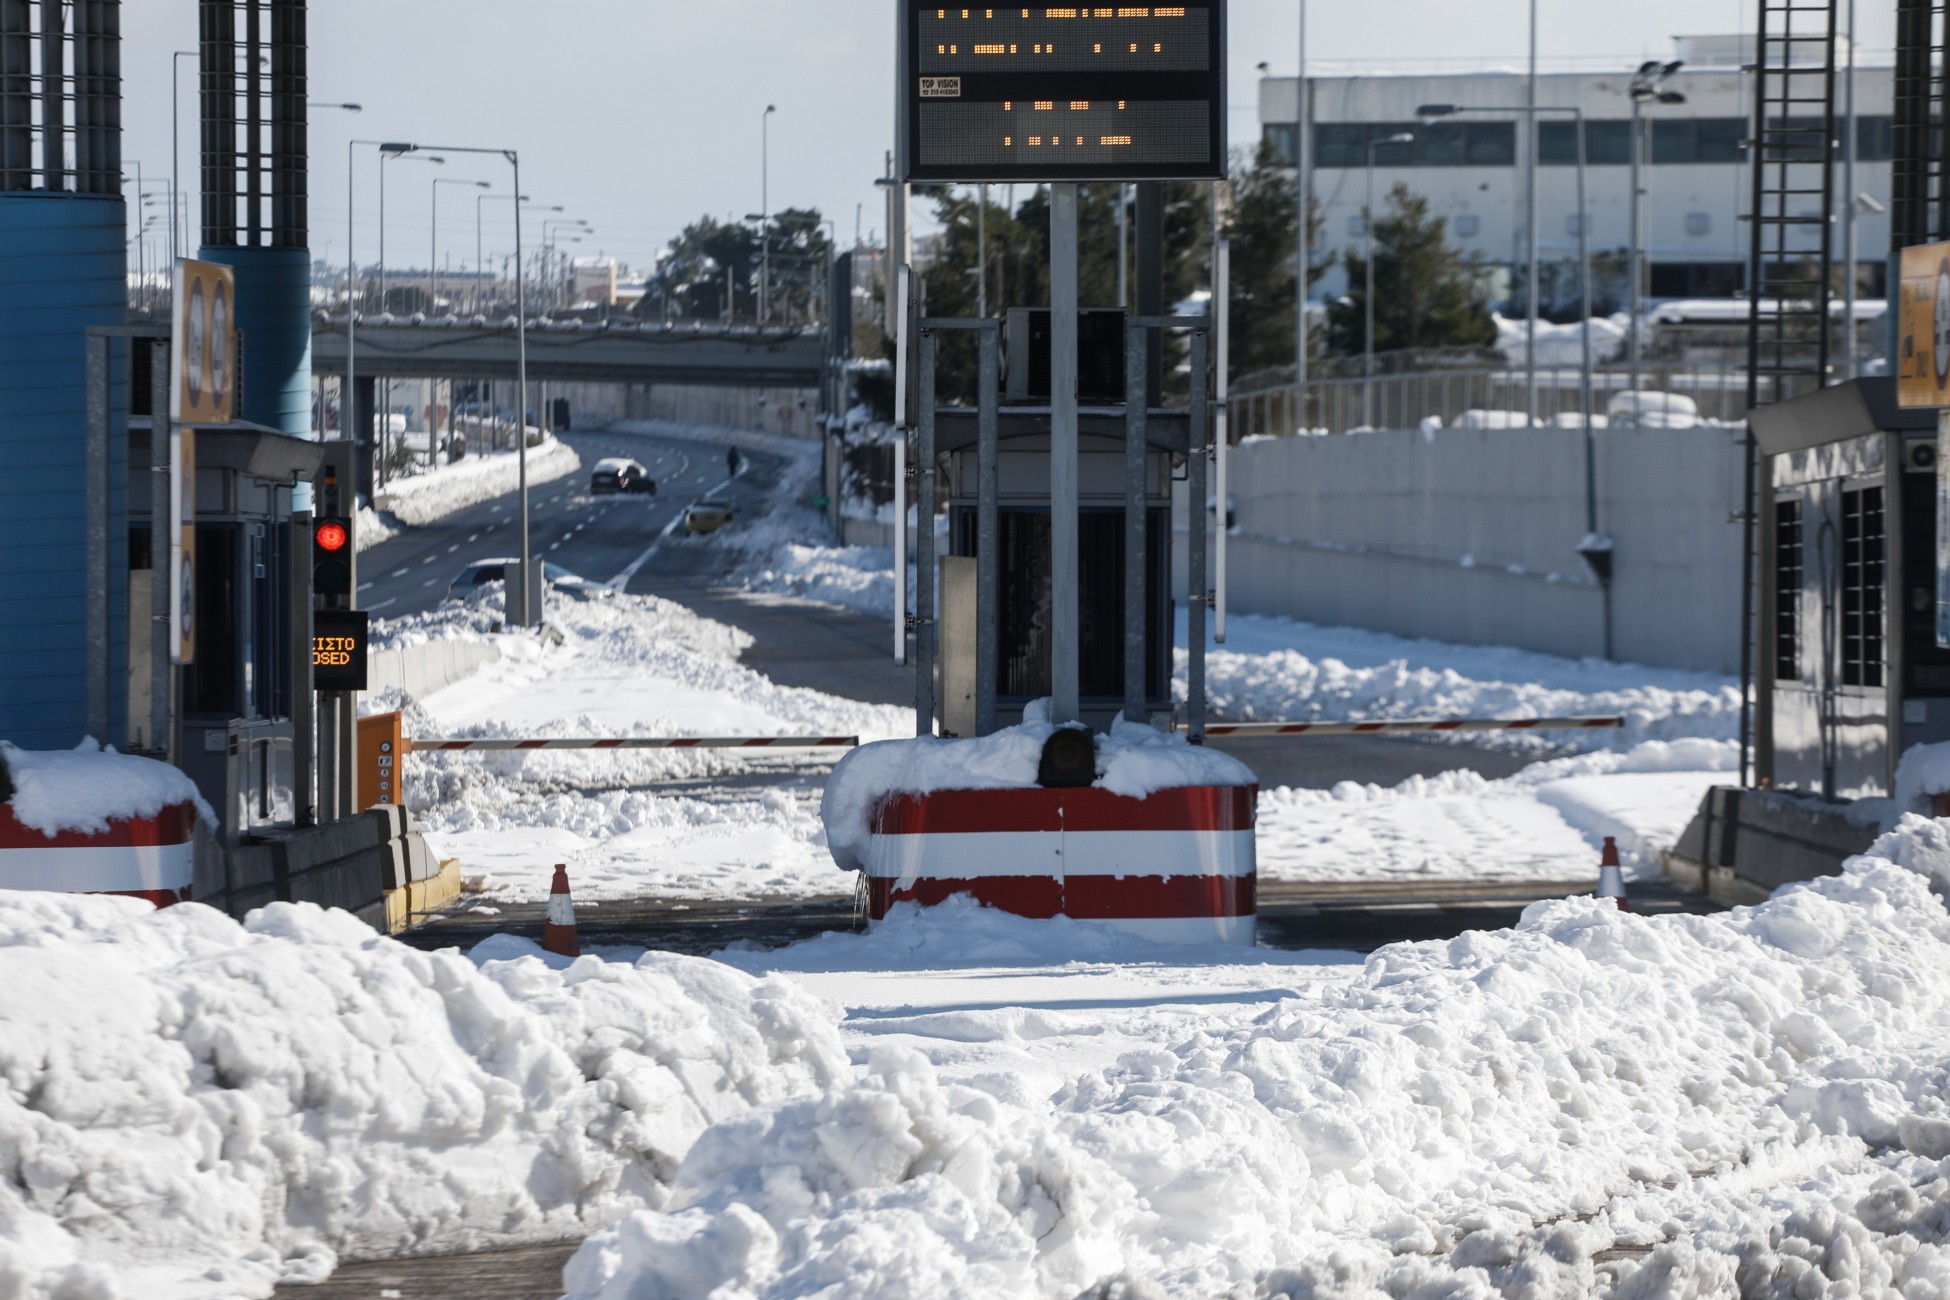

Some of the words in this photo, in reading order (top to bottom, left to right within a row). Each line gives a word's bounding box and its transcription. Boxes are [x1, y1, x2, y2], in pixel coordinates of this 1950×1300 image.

[922, 79, 934, 89] TOP
[937, 79, 958, 89] VISION
[312, 637, 355, 651] ΙΣΤΟ
